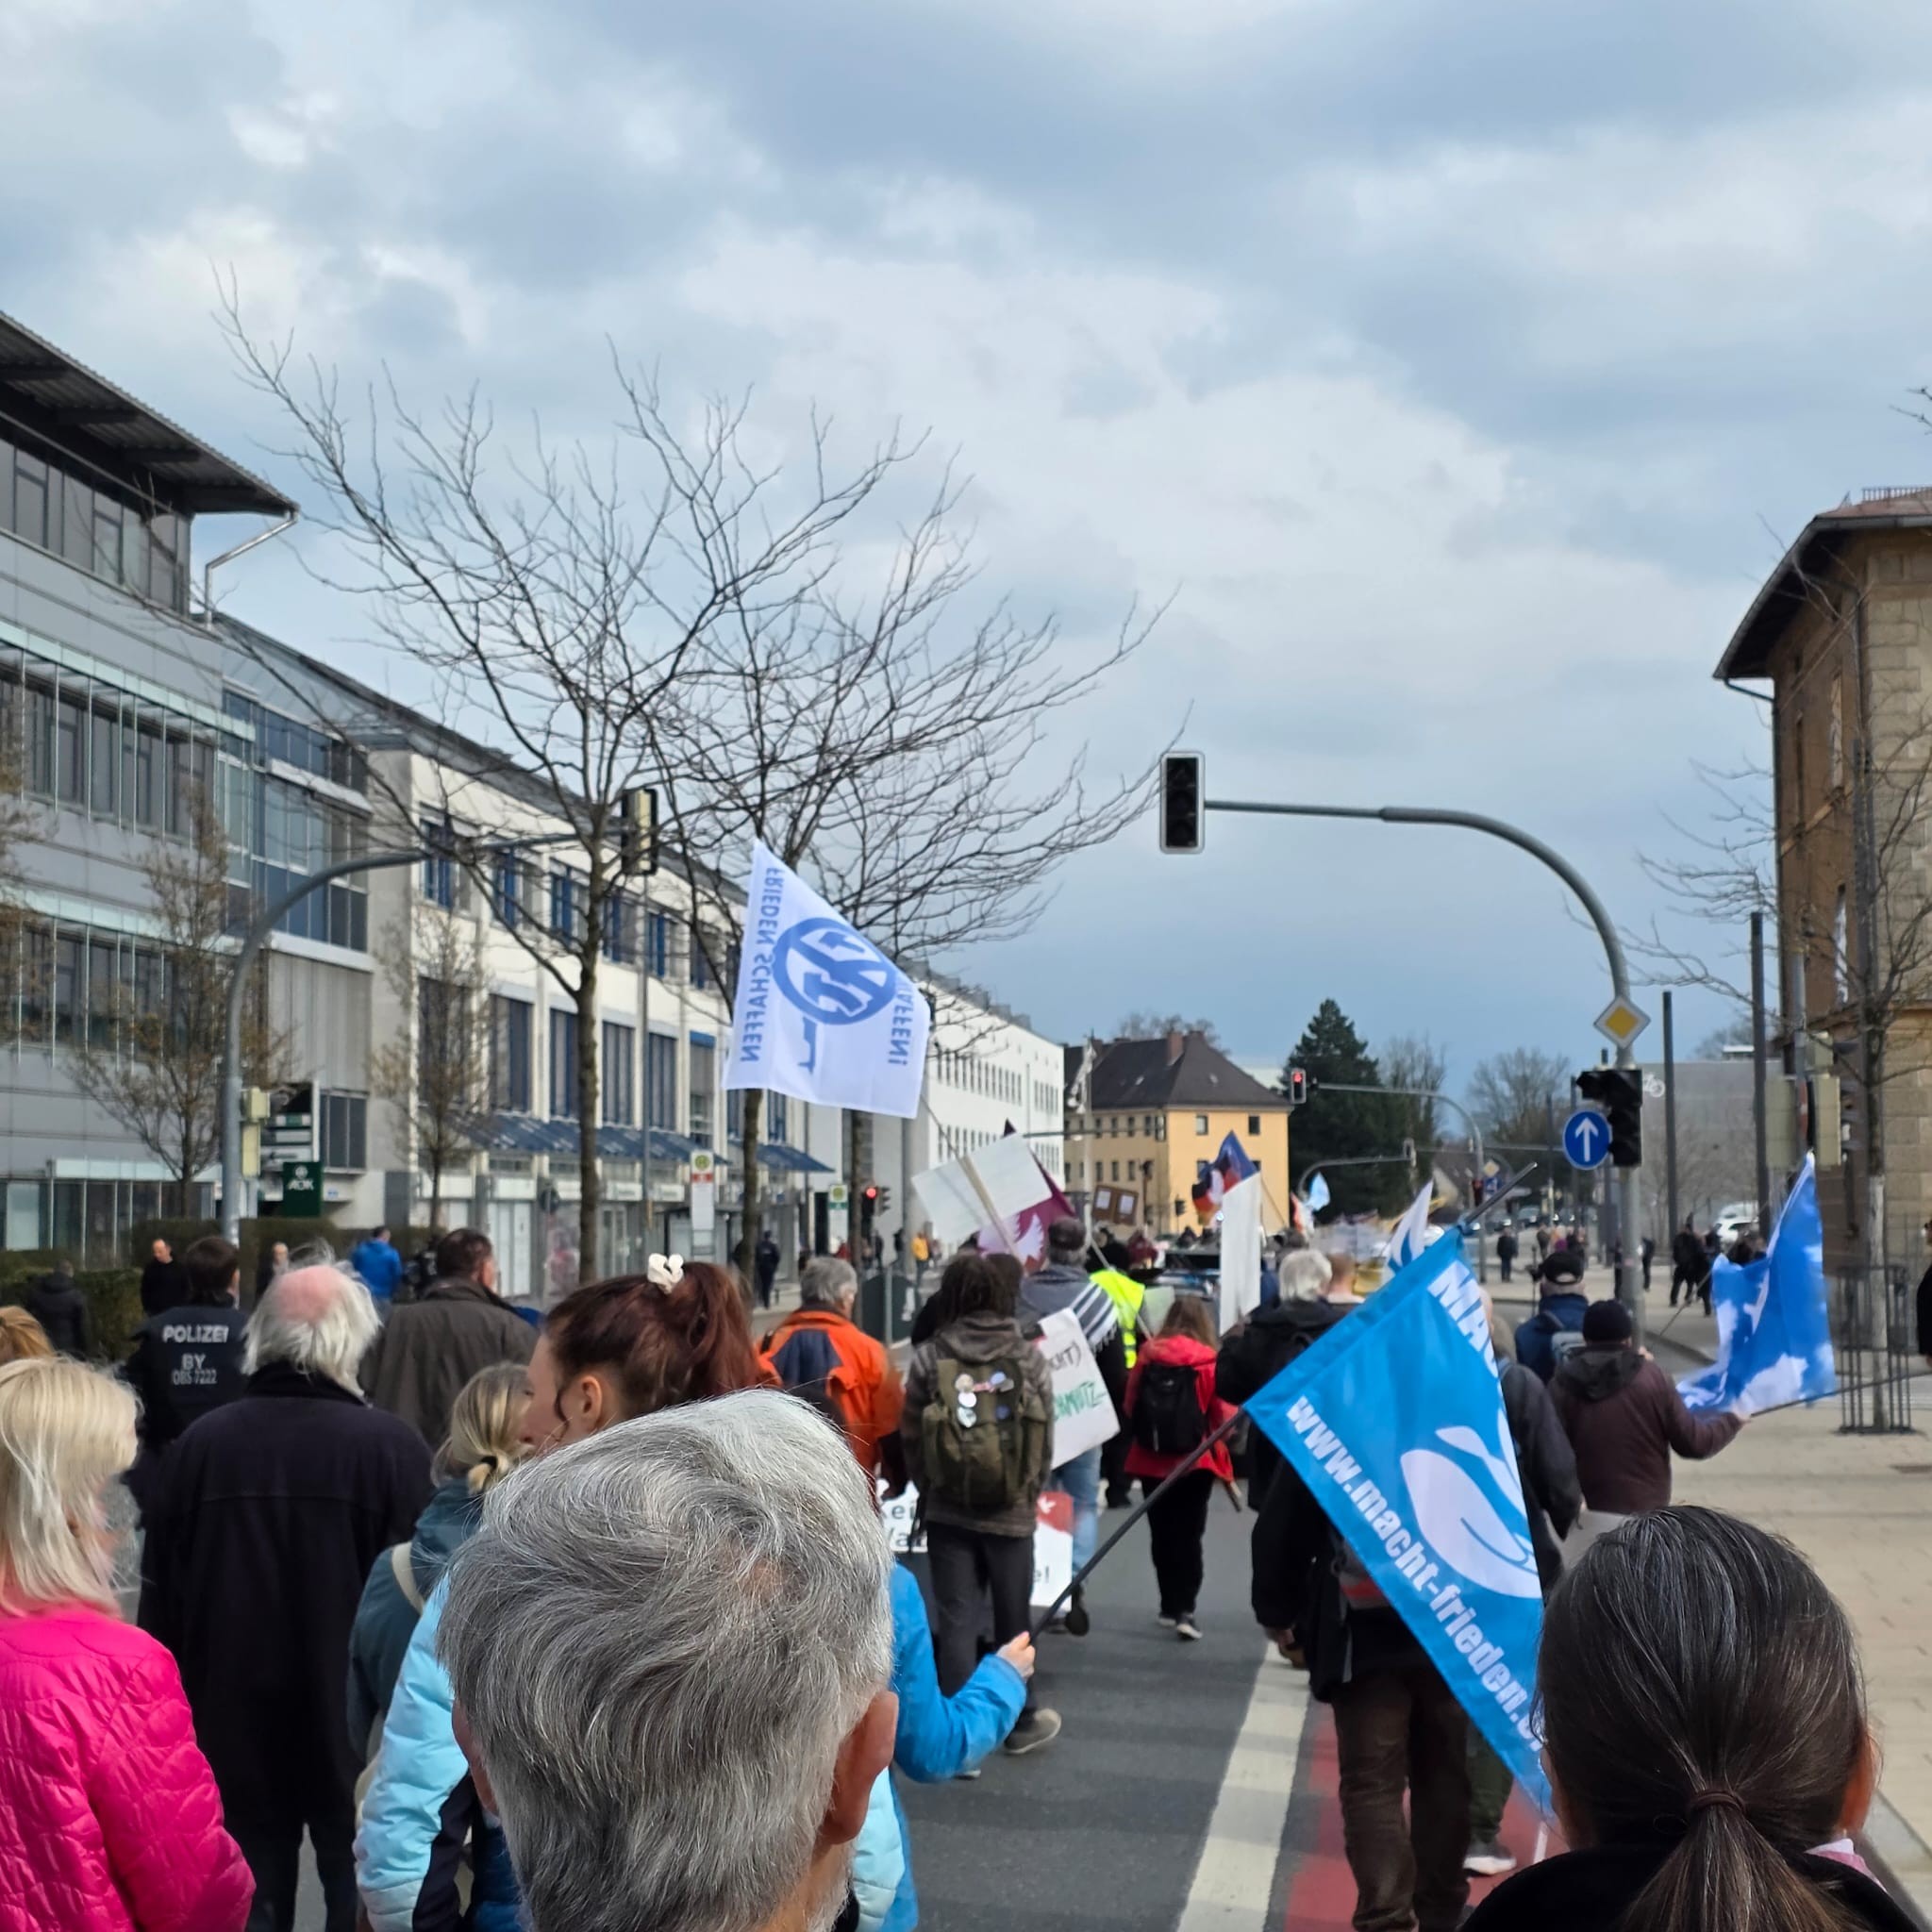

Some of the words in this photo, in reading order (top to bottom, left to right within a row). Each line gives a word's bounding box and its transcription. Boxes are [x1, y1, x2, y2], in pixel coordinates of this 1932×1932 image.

[288, 1179, 314, 1191] AOK
[162, 1324, 229, 1343] POLIZEI
[181, 1353, 206, 1370] BY
